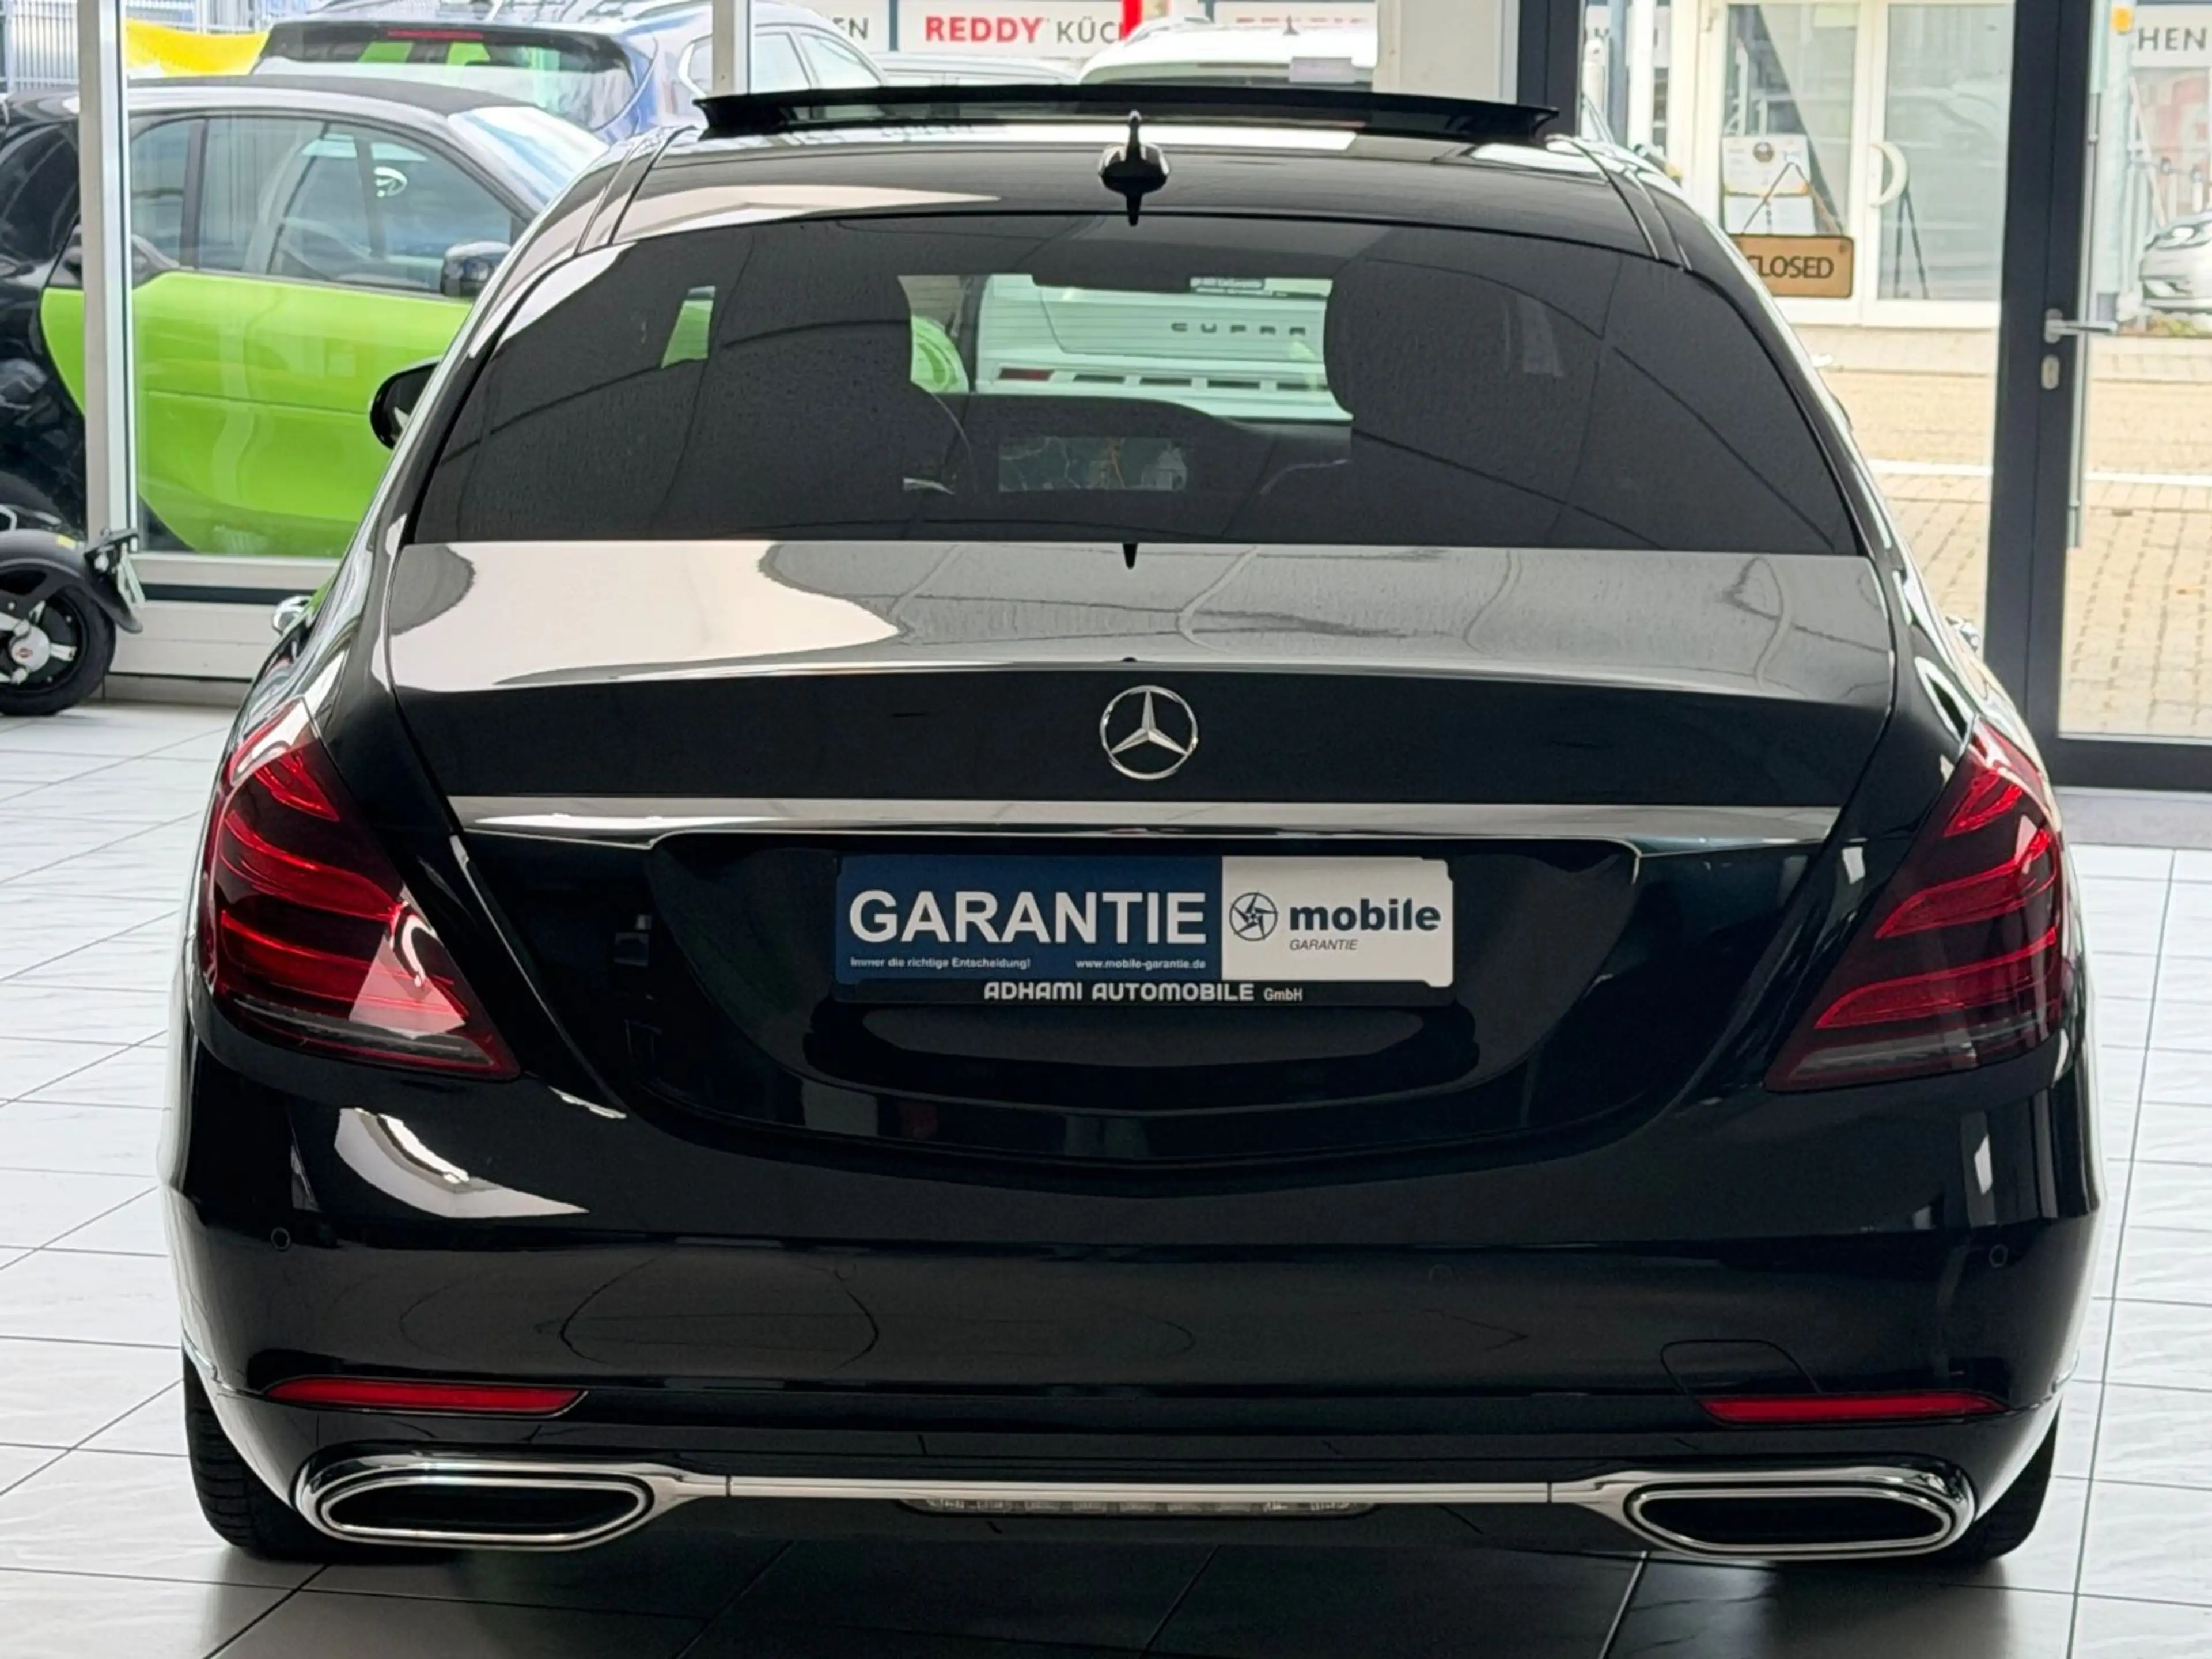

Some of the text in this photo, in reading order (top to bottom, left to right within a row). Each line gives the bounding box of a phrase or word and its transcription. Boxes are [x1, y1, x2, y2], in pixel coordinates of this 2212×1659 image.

[925, 17, 1041, 43] REDDY
[1171, 323, 1306, 335] CUPRA
[849, 890, 1206, 944] GARANTIE
[1290, 897, 1441, 931] mobile
[1289, 939, 1358, 951] GARANTIE
[850, 957, 1031, 970] Immer die richtige Entscheidung!
[1075, 957, 1206, 971] www.mobile-garantie.de
[984, 981, 1303, 1002] ADHAMI AUTOMOBILE GmbH
